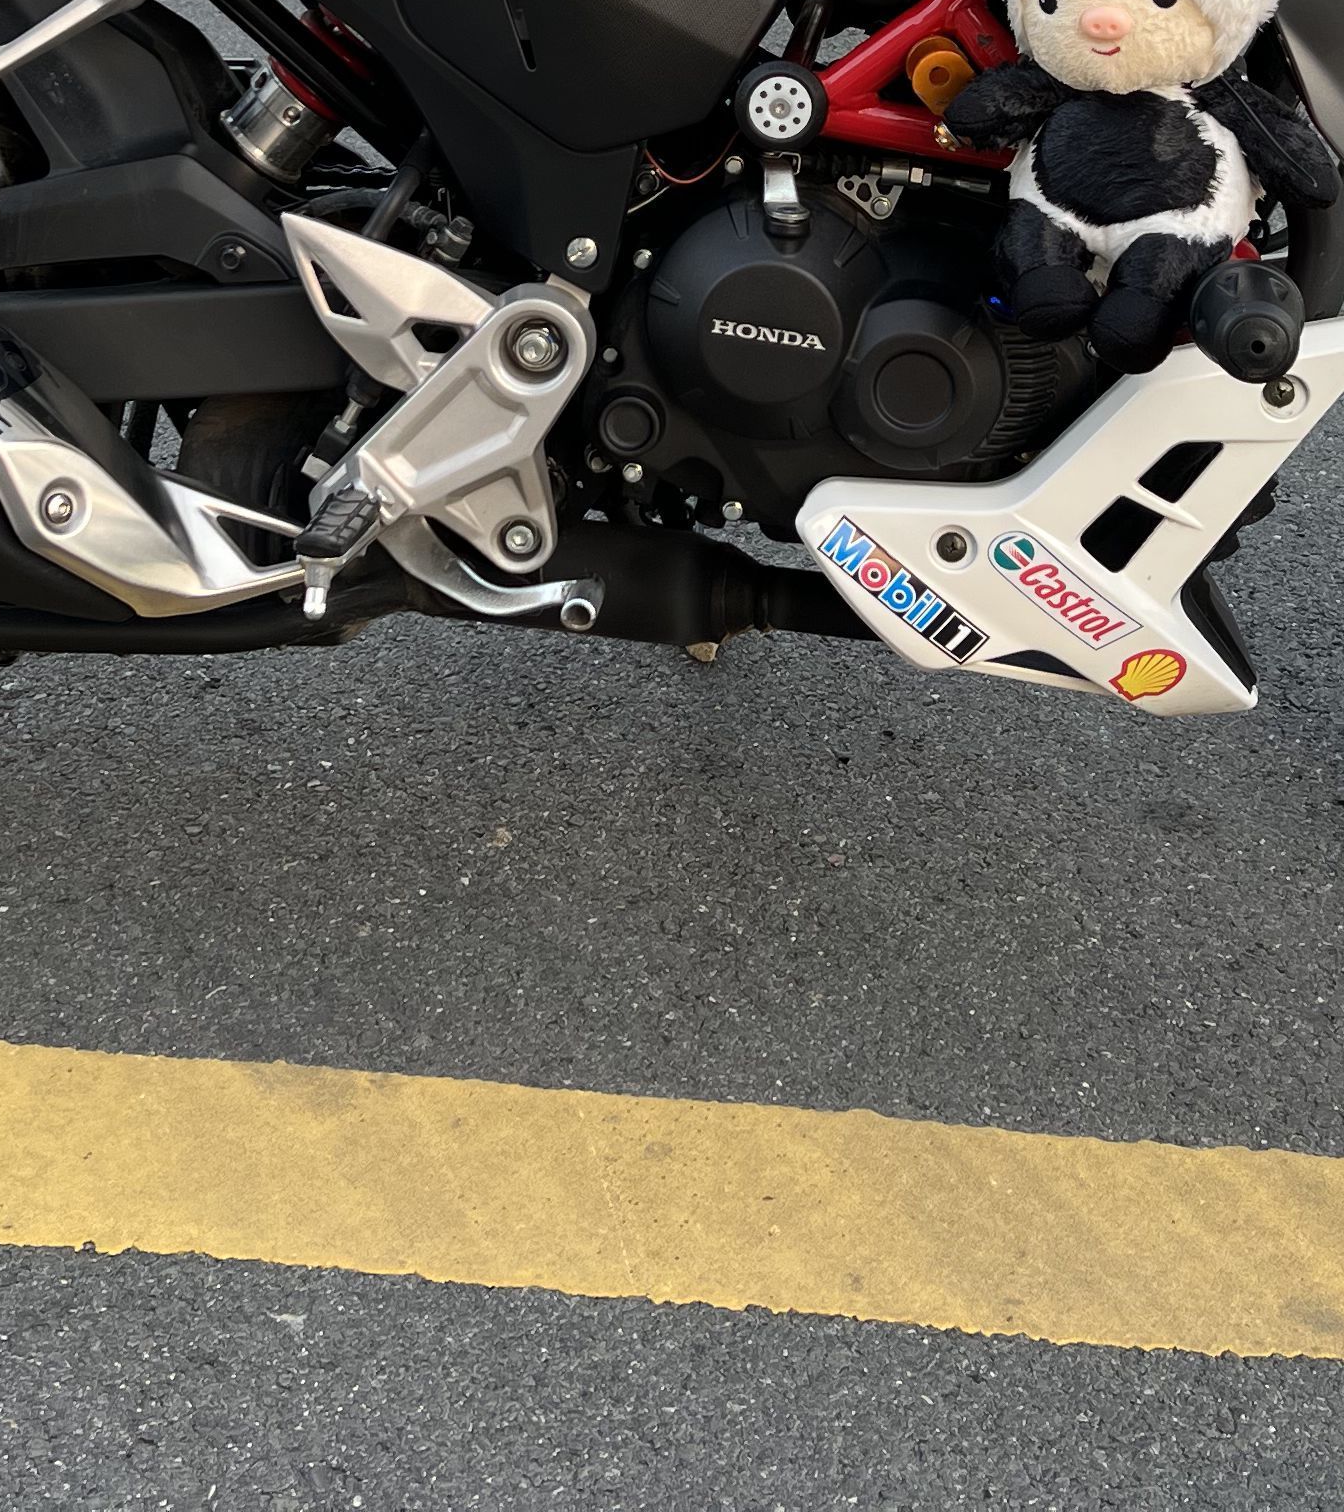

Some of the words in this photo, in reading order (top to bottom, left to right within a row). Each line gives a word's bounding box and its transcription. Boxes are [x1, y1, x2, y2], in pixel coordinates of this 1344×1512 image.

[711, 317, 827, 351] HONDA
[819, 519, 947, 632] Mobil
[1017, 562, 1127, 644] Castrol
